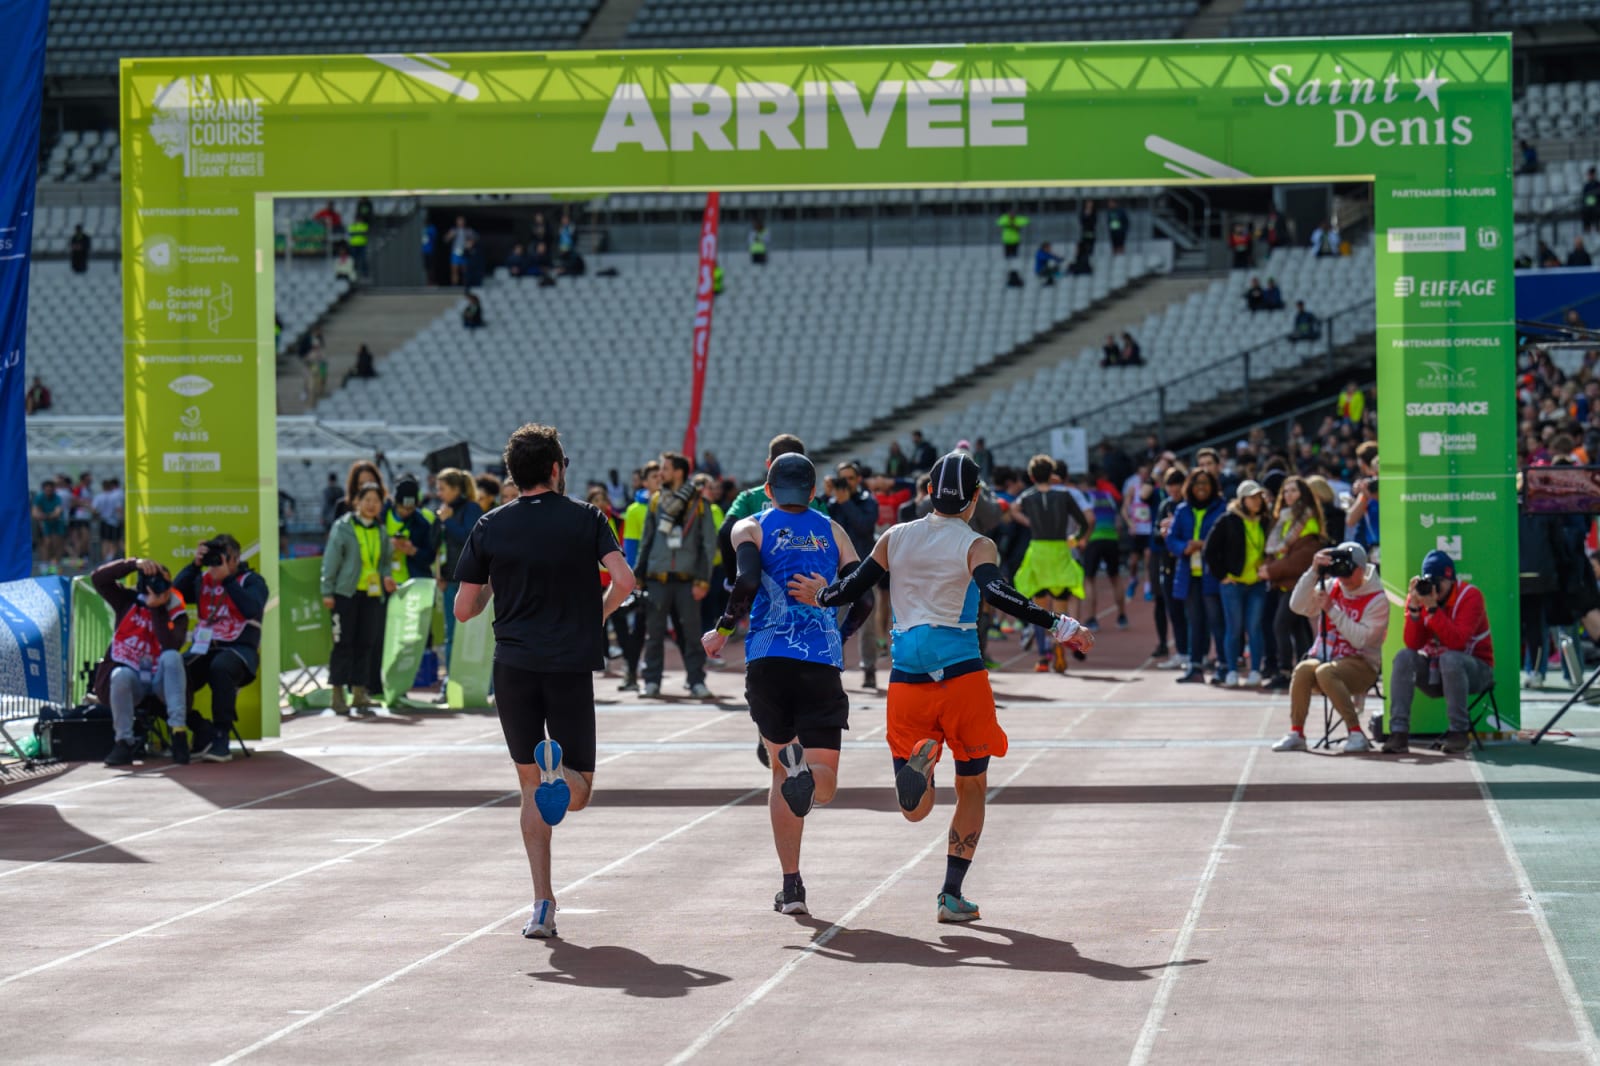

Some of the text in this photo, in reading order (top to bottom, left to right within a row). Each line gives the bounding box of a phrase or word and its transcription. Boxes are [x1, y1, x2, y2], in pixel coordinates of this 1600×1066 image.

[191, 74, 214, 97] LA
[1264, 64, 1400, 107] Saint
[191, 99, 264, 121] GRANDE
[591, 60, 1028, 152] ARRIVÉE
[191, 123, 264, 146] COURSE
[1333, 109, 1473, 147] Denis
[1391, 187, 1497, 198] PARTENAIRES MAJEURS
[138, 207, 239, 217] PARTENAIRES MAJEURS
[167, 285, 211, 298] Société
[1419, 279, 1497, 297] EIFFAGE
[148, 299, 204, 311] du Grand
[168, 312, 198, 323] Paris
[1392, 337, 1501, 348] PARTENAIRES OFFICIELS
[173, 431, 209, 441] PARIS
[1400, 491, 1497, 502] PARTENAIRES MÉDIAS
